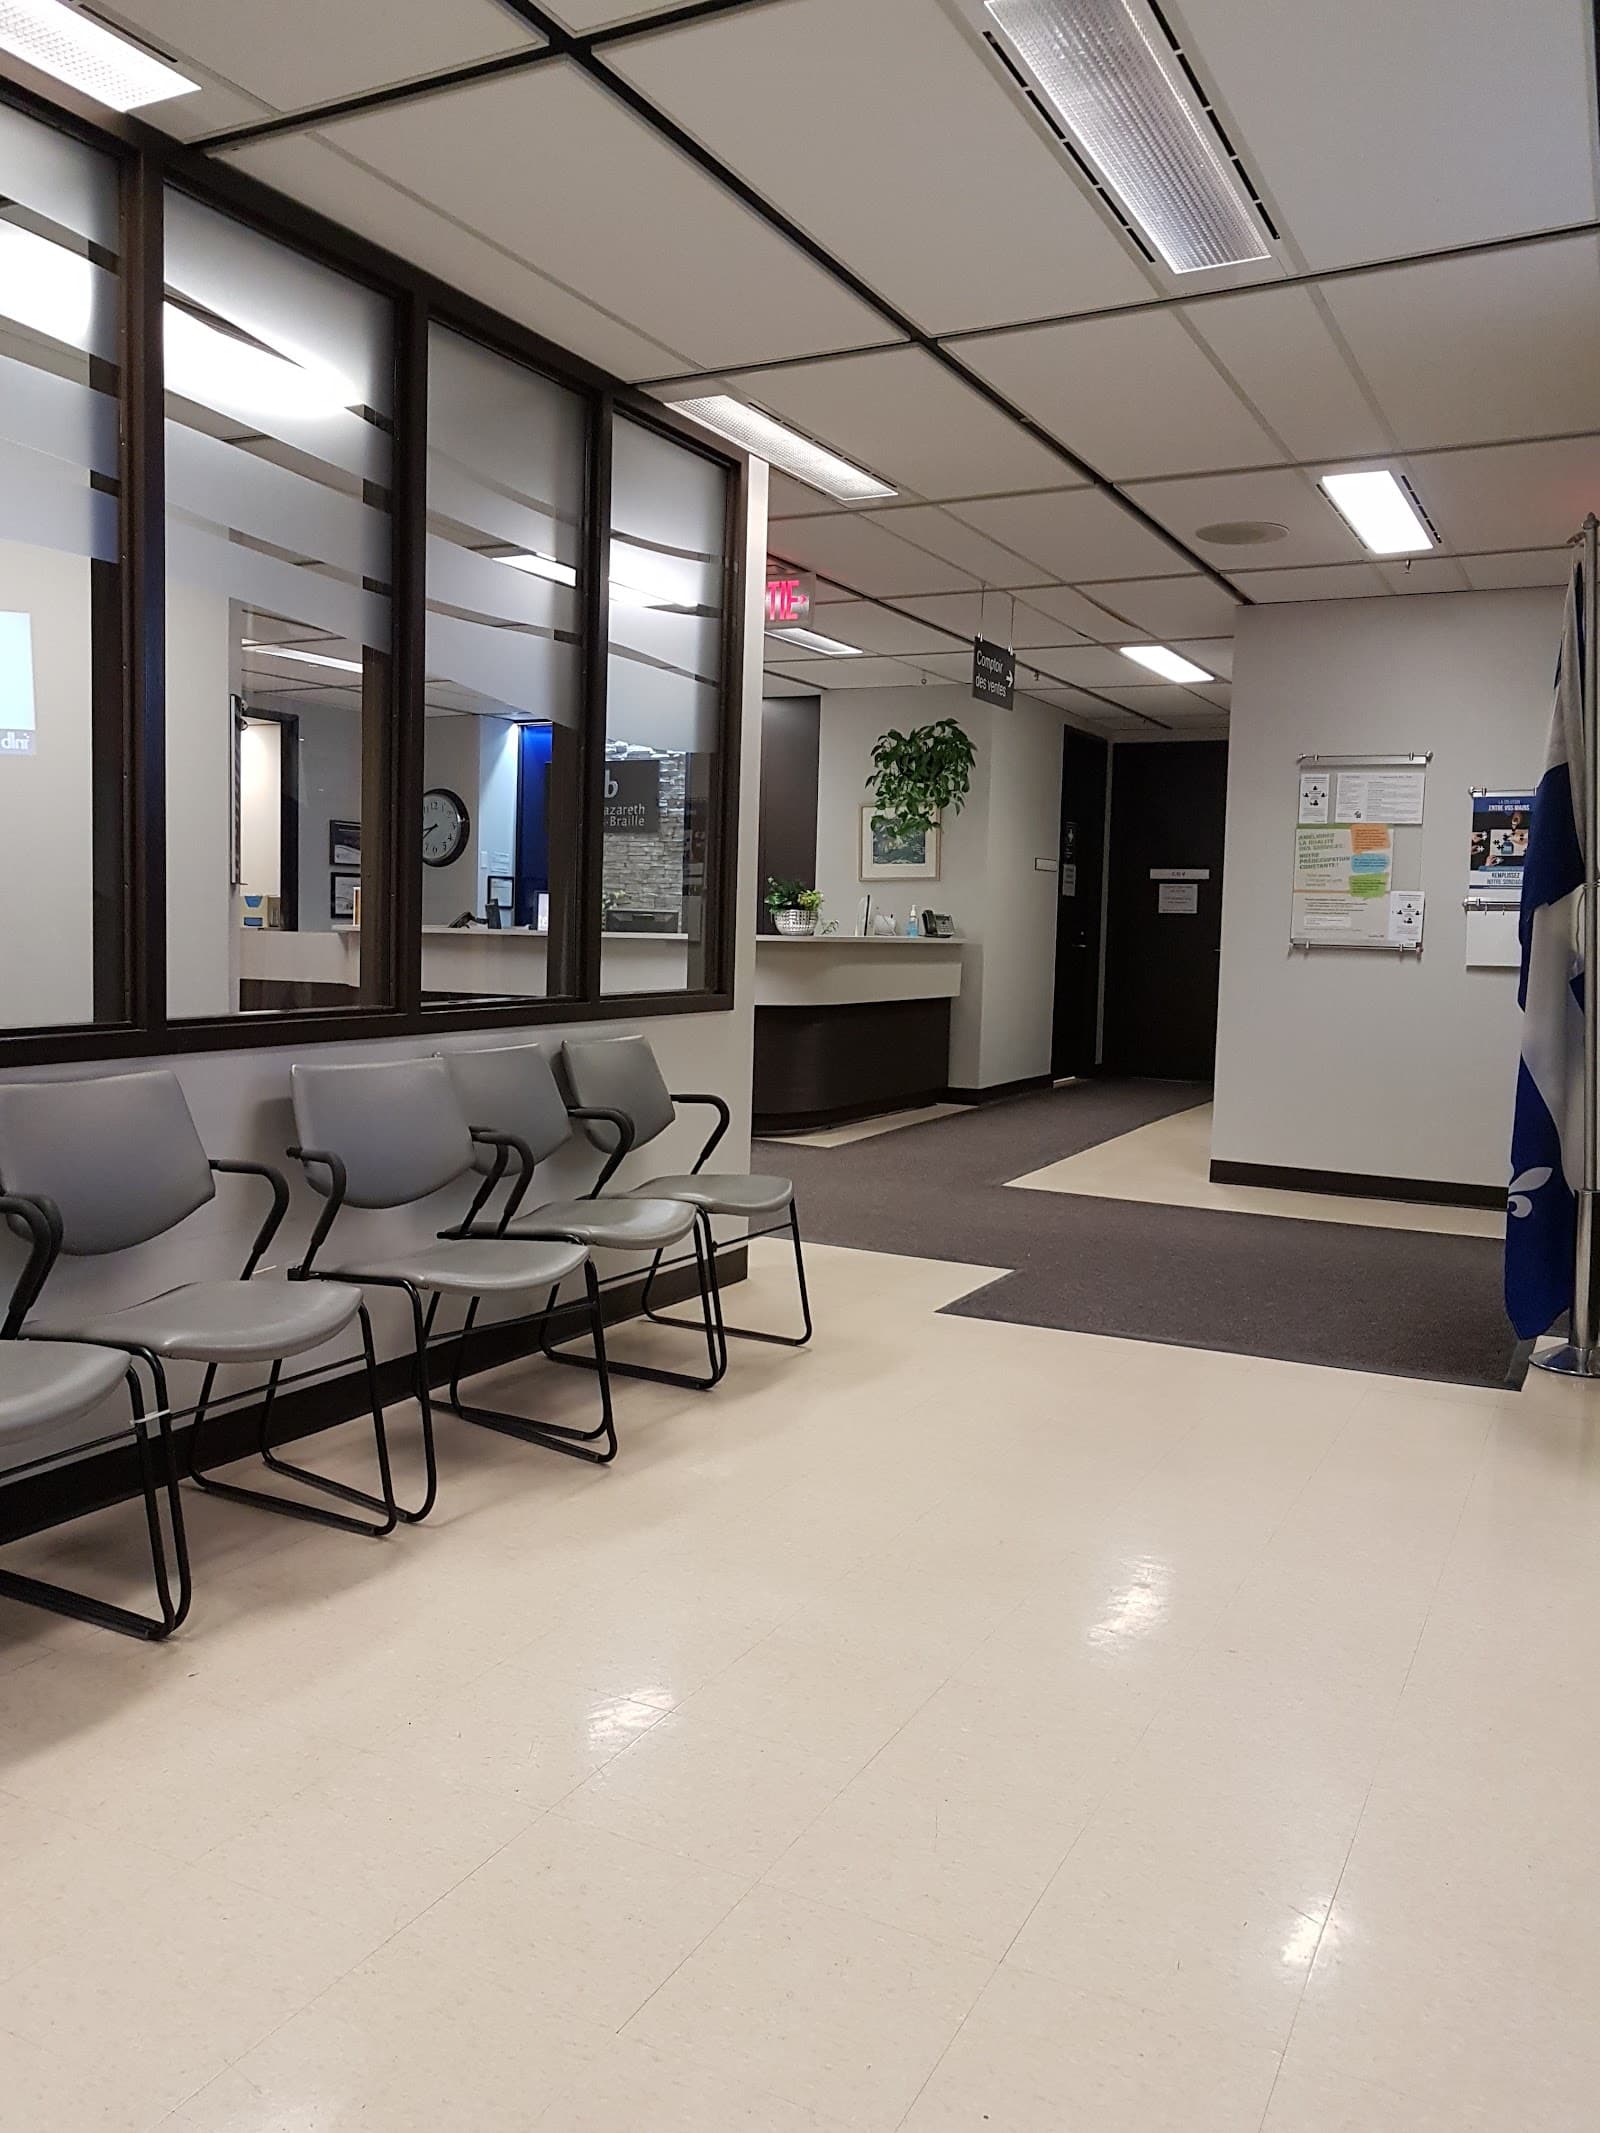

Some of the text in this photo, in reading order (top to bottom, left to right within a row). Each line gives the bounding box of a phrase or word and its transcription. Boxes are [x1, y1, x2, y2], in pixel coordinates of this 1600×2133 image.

[767, 579, 800, 621] TIE
[976, 649, 1003, 674] Comptoir
[975, 673, 1007, 697] des ventes
[604, 803, 645, 816] azareth
